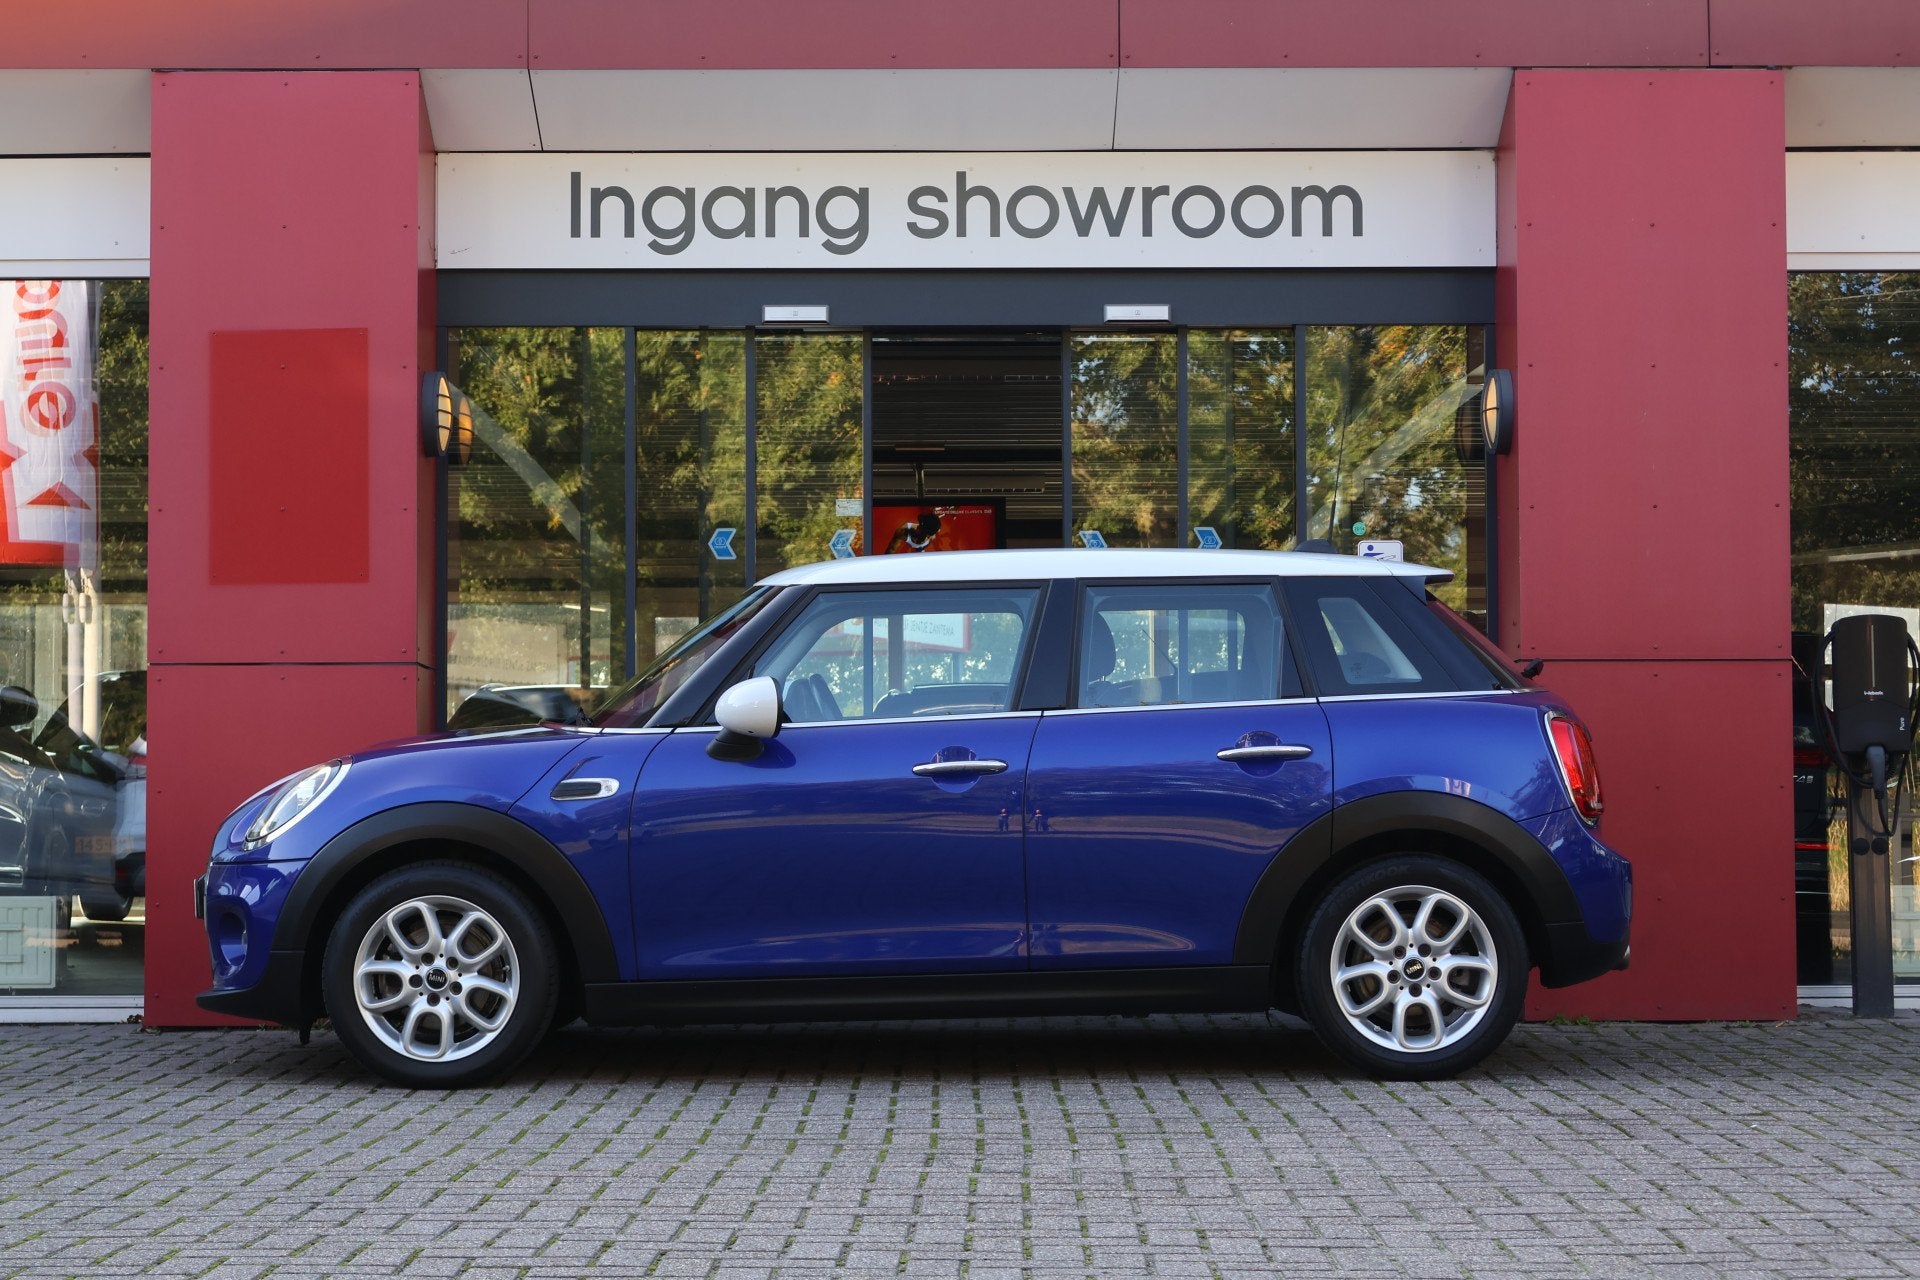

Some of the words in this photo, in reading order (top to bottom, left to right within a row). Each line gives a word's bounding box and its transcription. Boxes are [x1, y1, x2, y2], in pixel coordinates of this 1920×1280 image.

[571, 172, 869, 256] Ingang
[906, 171, 1364, 239] showroom
[1406, 962, 1422, 975] MINI
[429, 974, 445, 983] MINI
